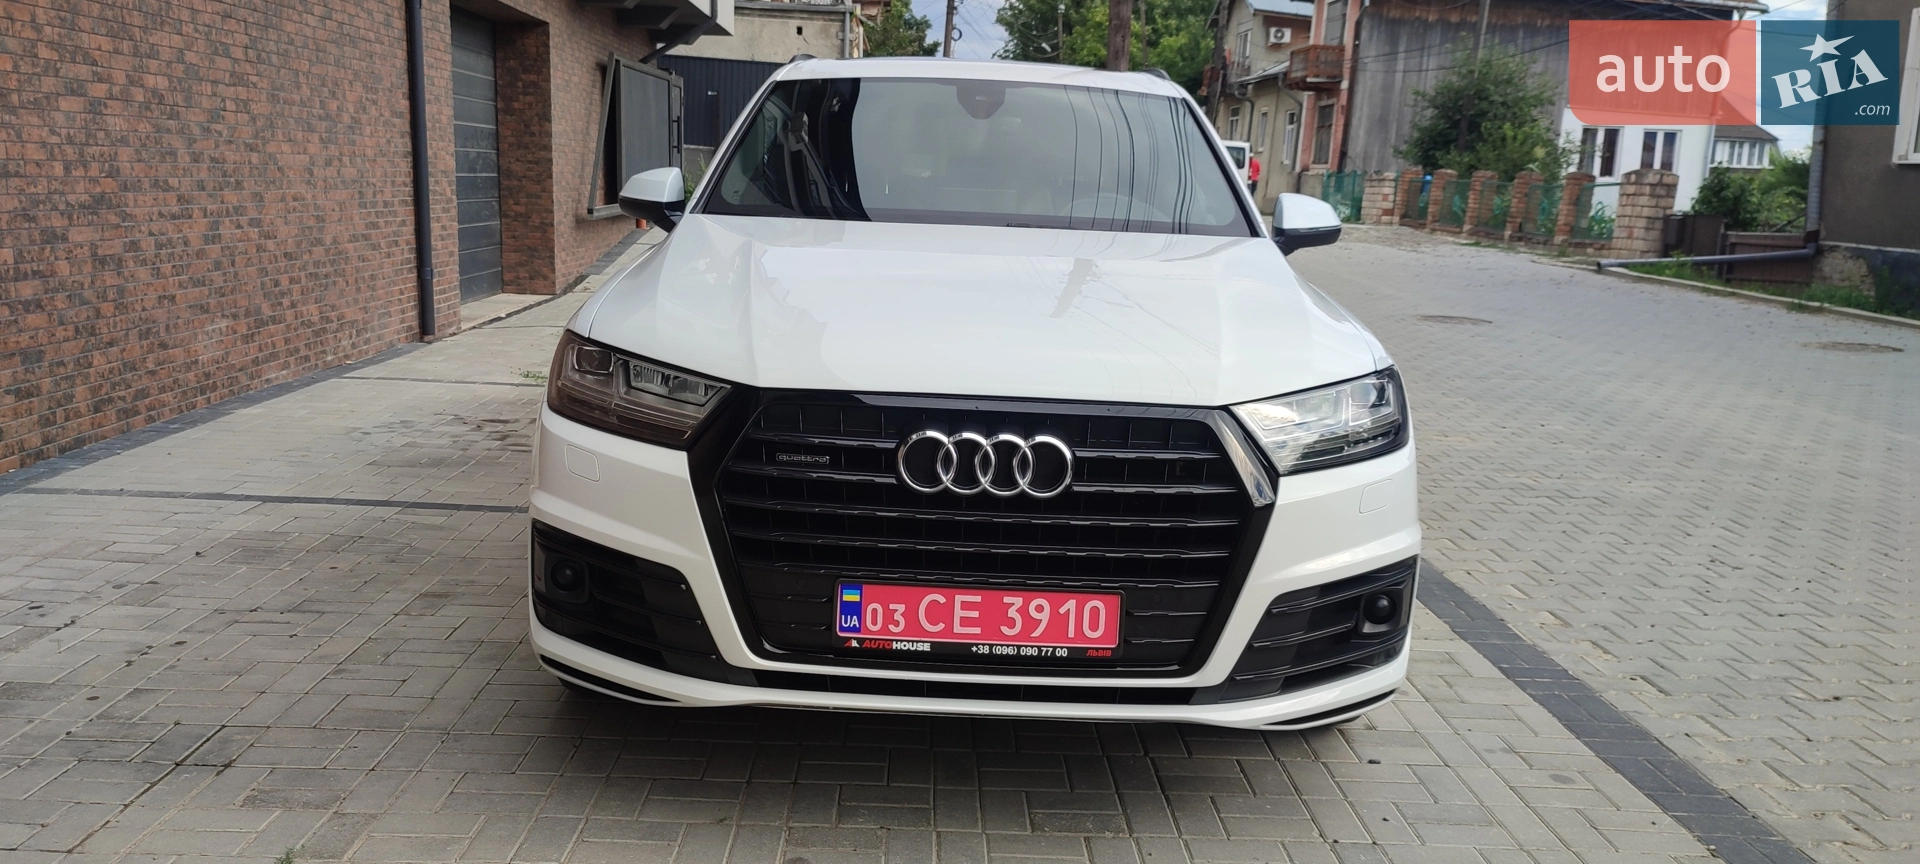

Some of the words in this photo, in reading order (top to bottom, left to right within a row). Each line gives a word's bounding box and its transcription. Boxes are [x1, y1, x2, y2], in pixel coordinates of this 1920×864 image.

[778, 454, 827, 463] quattro
[841, 614, 860, 628] UA
[865, 602, 906, 633] 03
[918, 593, 981, 634] CE
[1000, 596, 1106, 639] 3910
[862, 639, 931, 651] AUTOHOUSE
[971, 644, 990, 655] +38
[992, 645, 1018, 655] (096)
[1020, 646, 1038, 656] 090
[1041, 647, 1053, 657] 77
[1055, 647, 1068, 657] 00
